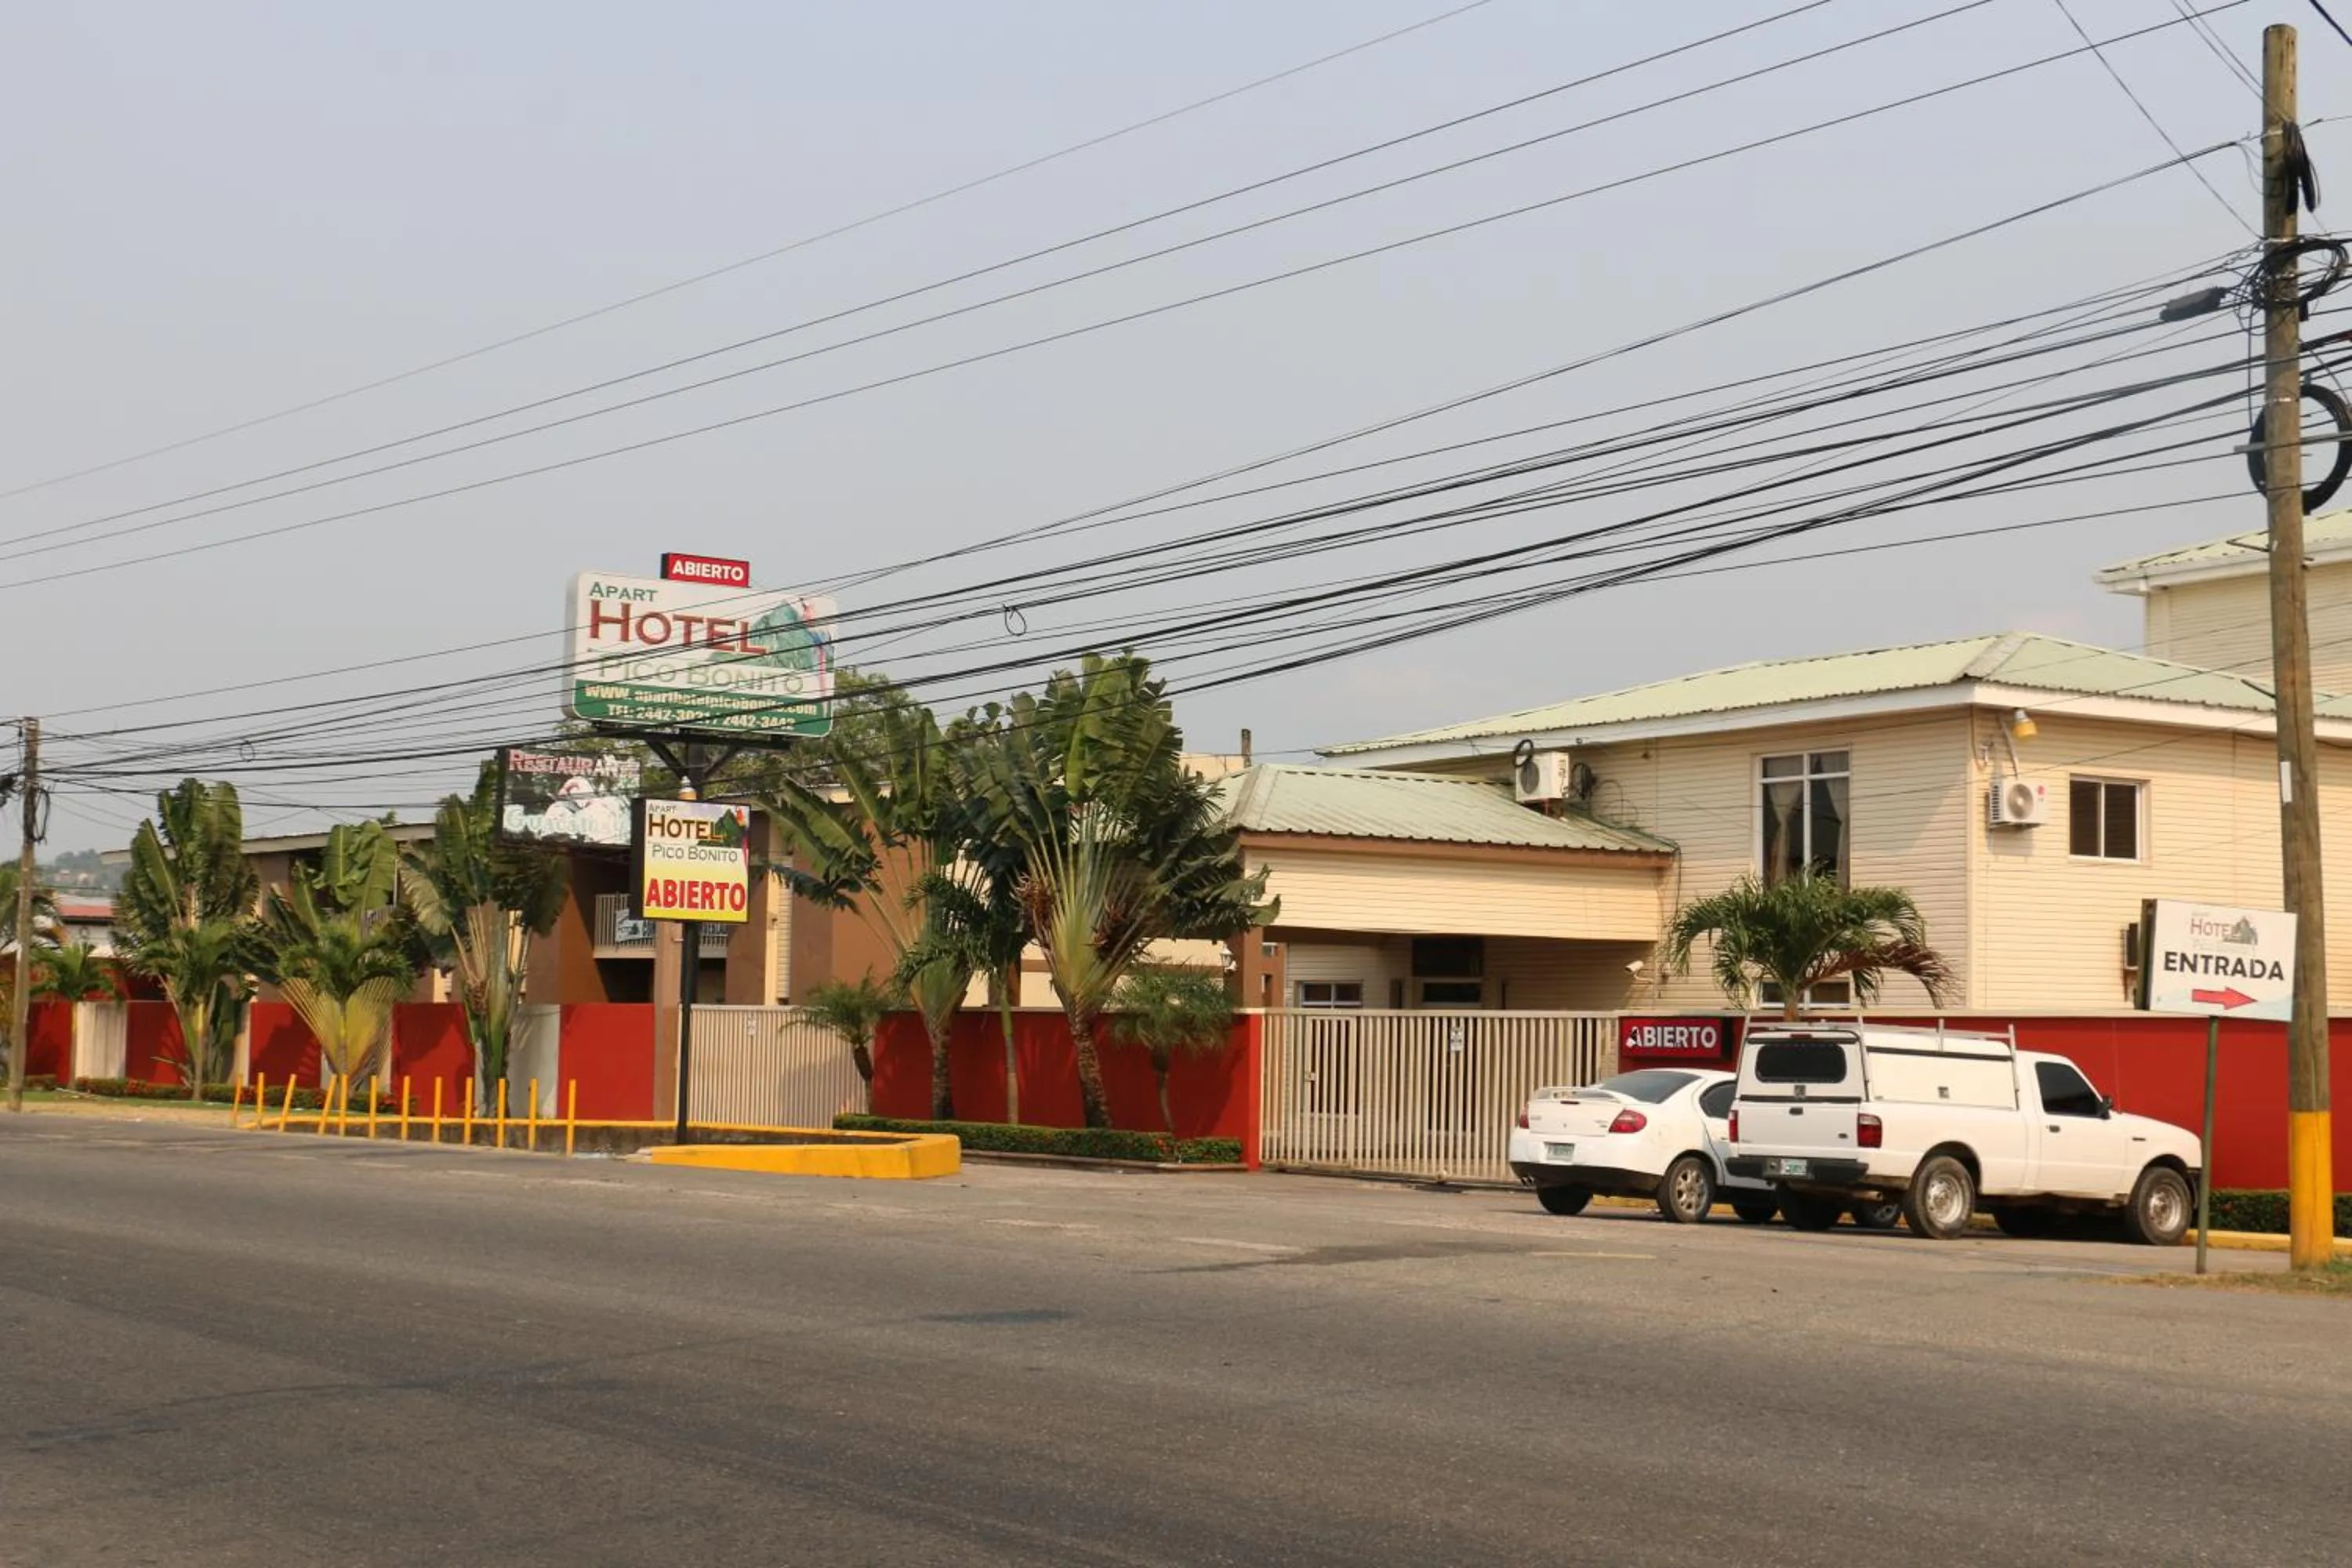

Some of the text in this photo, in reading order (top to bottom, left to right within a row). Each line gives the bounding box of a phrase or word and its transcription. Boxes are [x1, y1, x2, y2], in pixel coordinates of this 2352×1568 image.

[672, 560, 744, 581] ABIERTO
[590, 582, 659, 602] APART
[590, 599, 767, 655] HOTEL
[599, 654, 804, 694] PICO BONITO
[648, 803, 677, 813] APART
[648, 813, 724, 840] HOTEL
[652, 844, 738, 862] PICO BONITO
[645, 878, 746, 912] ABIERTO
[2163, 951, 2285, 981] ENTRADA
[1625, 1025, 1717, 1048] ABIERTO
